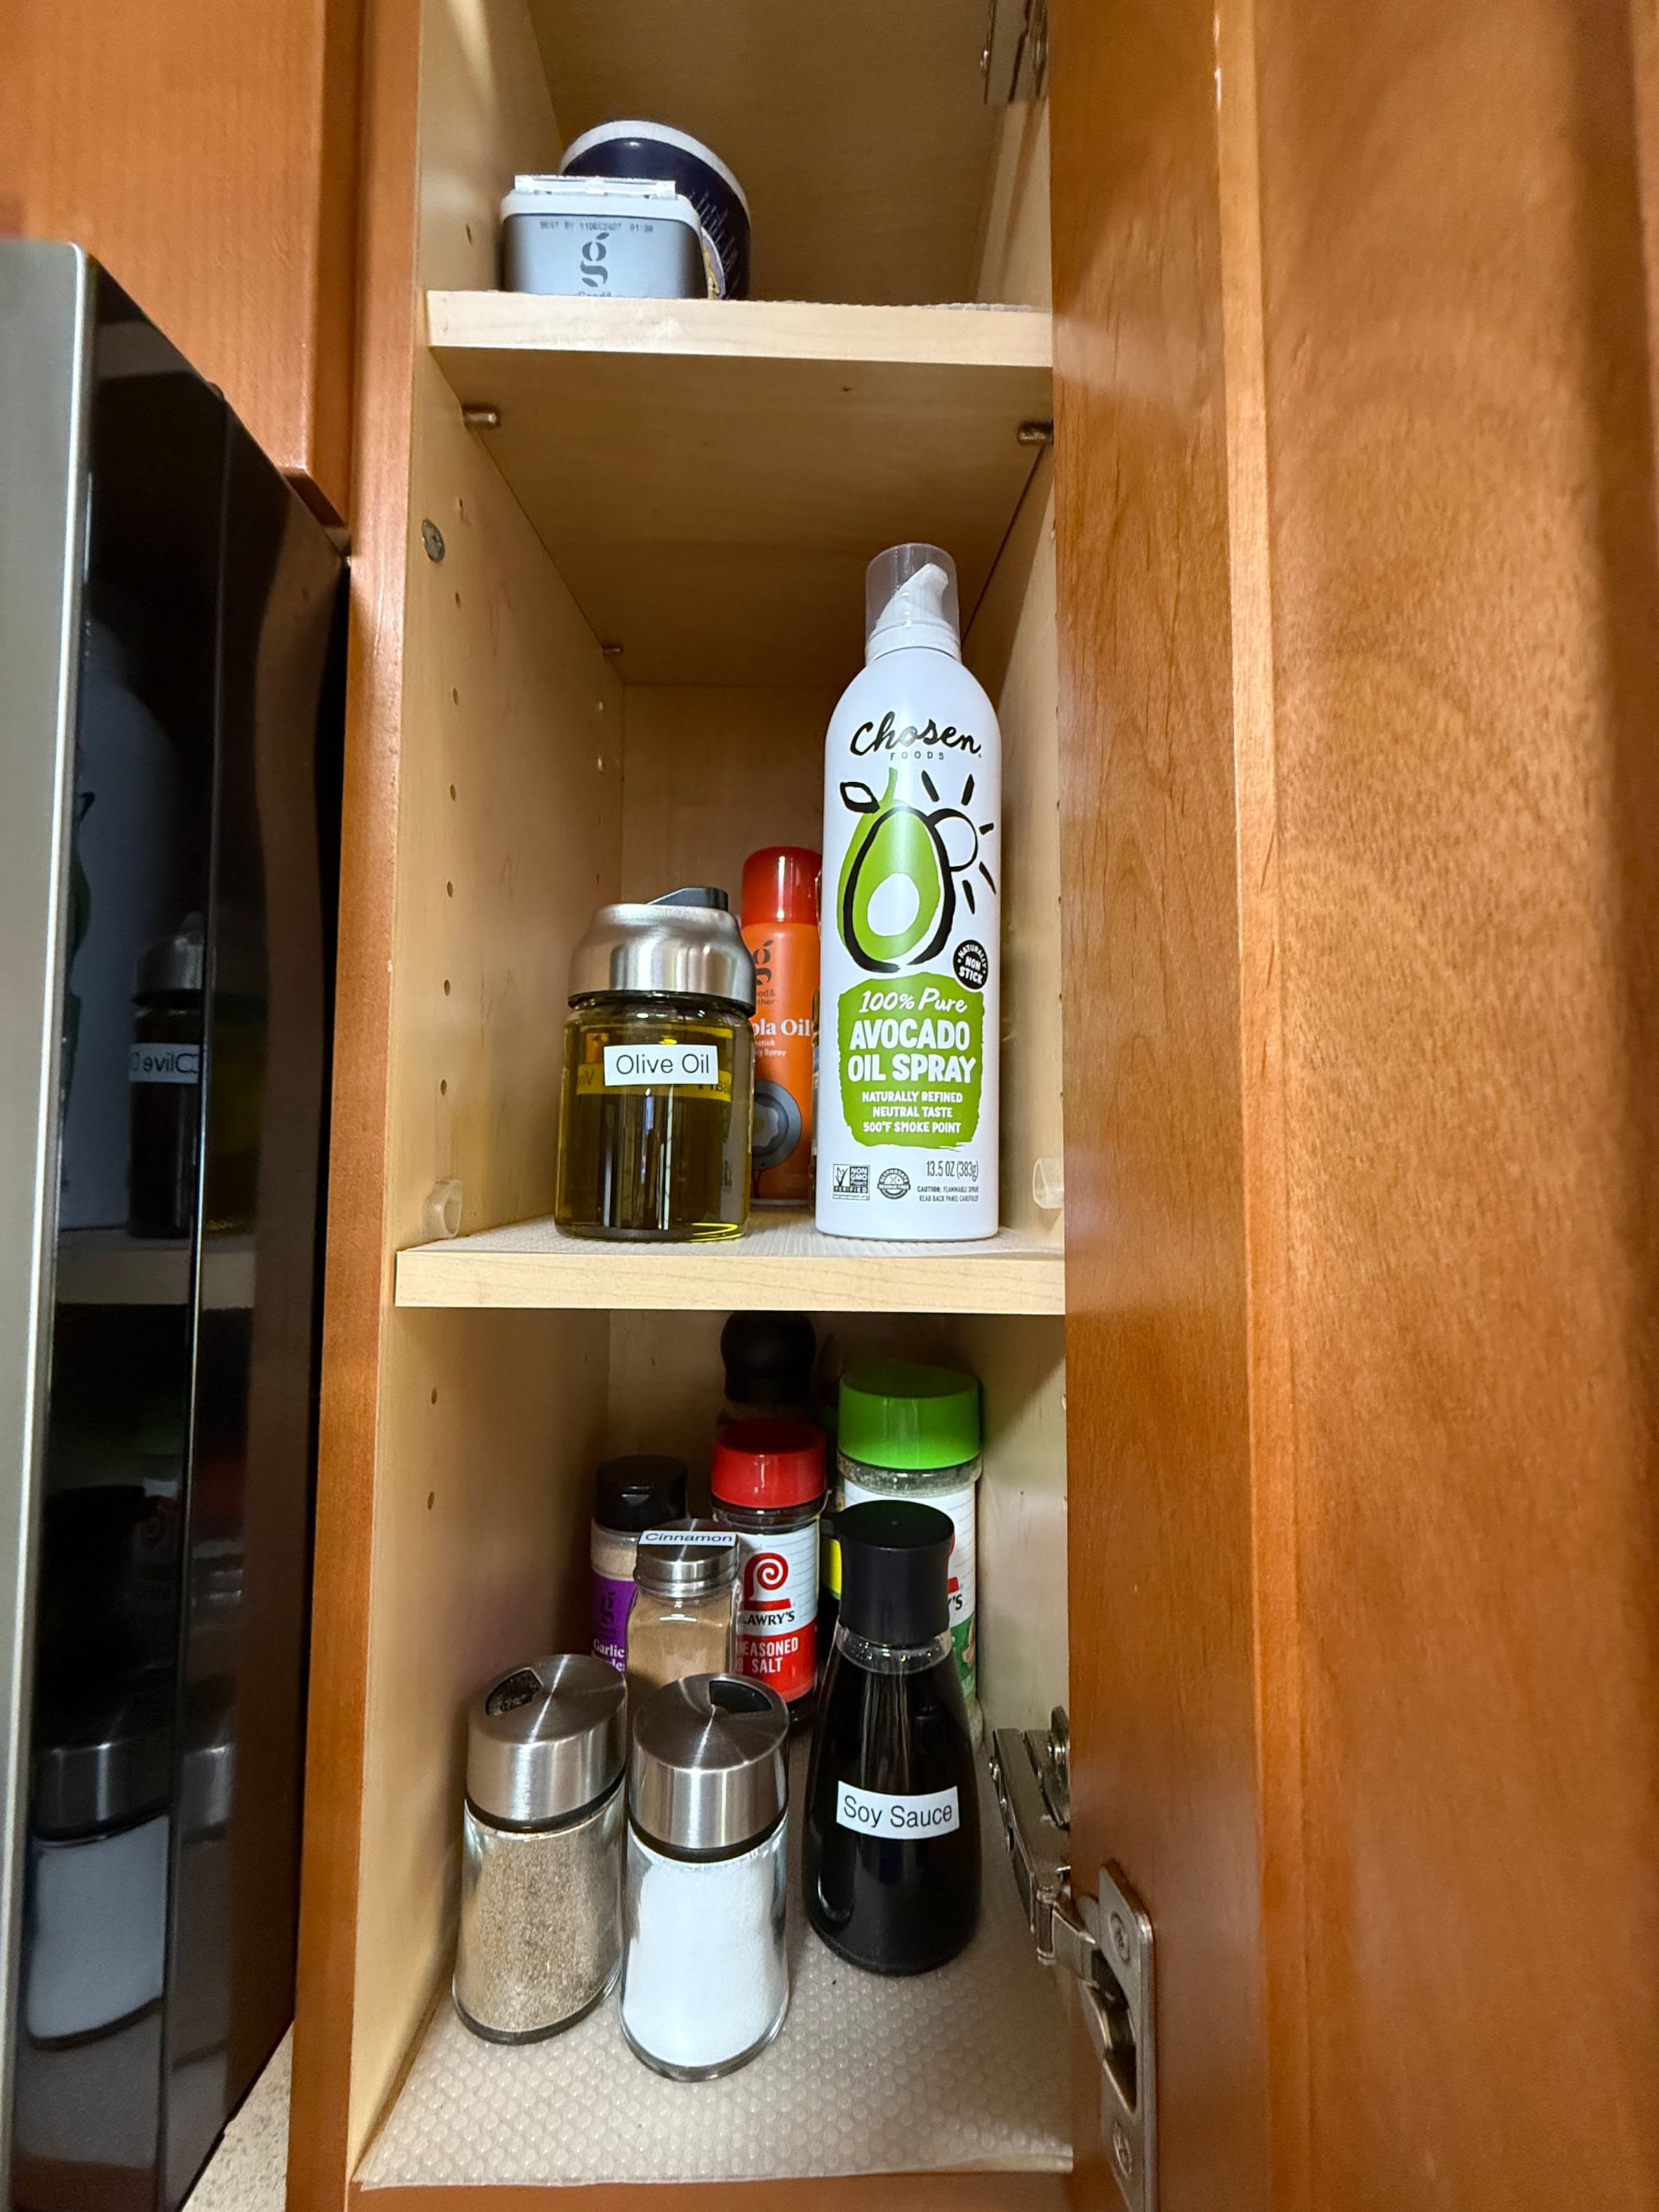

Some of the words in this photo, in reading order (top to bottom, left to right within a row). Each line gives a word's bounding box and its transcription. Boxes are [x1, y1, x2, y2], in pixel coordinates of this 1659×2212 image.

[850, 710, 982, 756] Chosen
[890, 751, 944, 761] FOODS
[965, 955, 981, 972] NON
[958, 966, 983, 985] STICK
[859, 990, 915, 1014] 100%
[917, 986, 968, 1014] Pure
[780, 1018, 810, 1036] Oil
[850, 1018, 970, 1051] AVOCADO
[616, 1053, 674, 1075] Olive
[682, 1053, 710, 1074] Oil
[848, 1054, 887, 1082] OIL
[892, 1053, 977, 1084] SPRAY
[861, 1091, 920, 1102] NATURALLY
[921, 1091, 964, 1103] REFINED
[872, 1106, 920, 1118] NEUTRAL
[921, 1106, 953, 1118] TASTE
[863, 1121, 892, 1133] 500°F
[894, 1121, 930, 1133] SMOKE
[932, 1122, 962, 1134] POINT
[926, 1160, 944, 1177] 13.5
[945, 1161, 955, 1177] OZ
[956, 1160, 979, 1182] (383g)
[645, 1532, 732, 1543] Cinnamon
[743, 1611, 795, 1626] AWRY'S
[593, 1638, 625, 1659] Garlic
[743, 1636, 798, 1658] EASONED
[751, 1656, 783, 1673] SALT
[844, 1795, 883, 1828] Soy
[890, 1804, 953, 1828] Sauce
